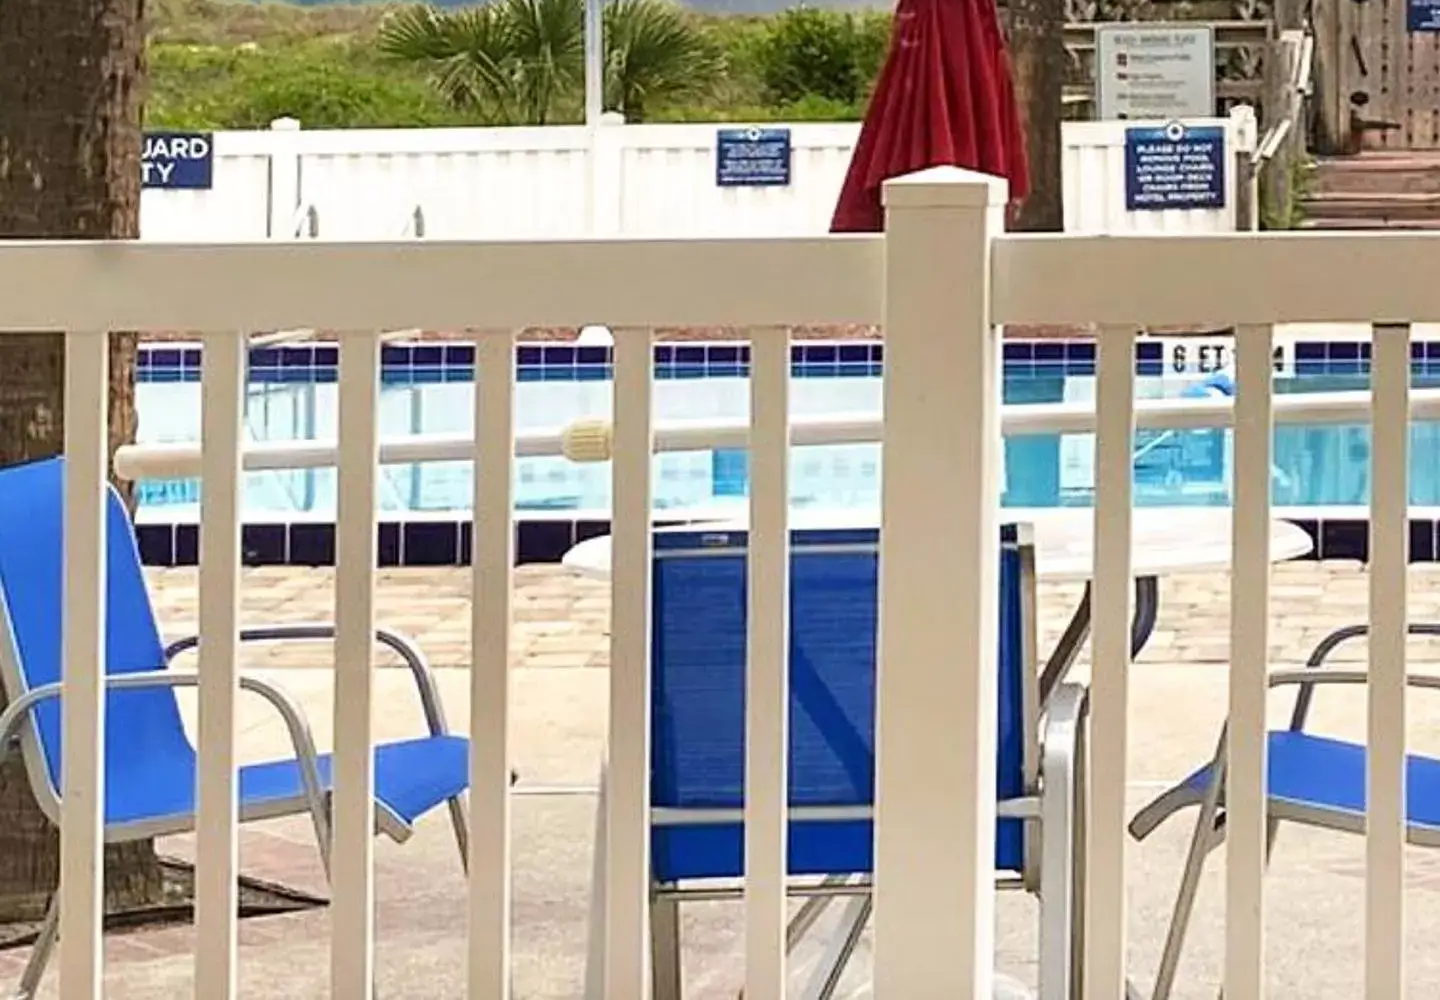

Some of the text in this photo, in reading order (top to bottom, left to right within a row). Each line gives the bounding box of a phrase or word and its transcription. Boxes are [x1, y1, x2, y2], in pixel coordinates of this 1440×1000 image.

[1135, 143, 1213, 154] PLEASE DO NOT
[1182, 154, 1210, 163] POOL
[1135, 164, 1176, 173] LOUNGE
[1134, 192, 1217, 202] HOTEL PROPERTY
